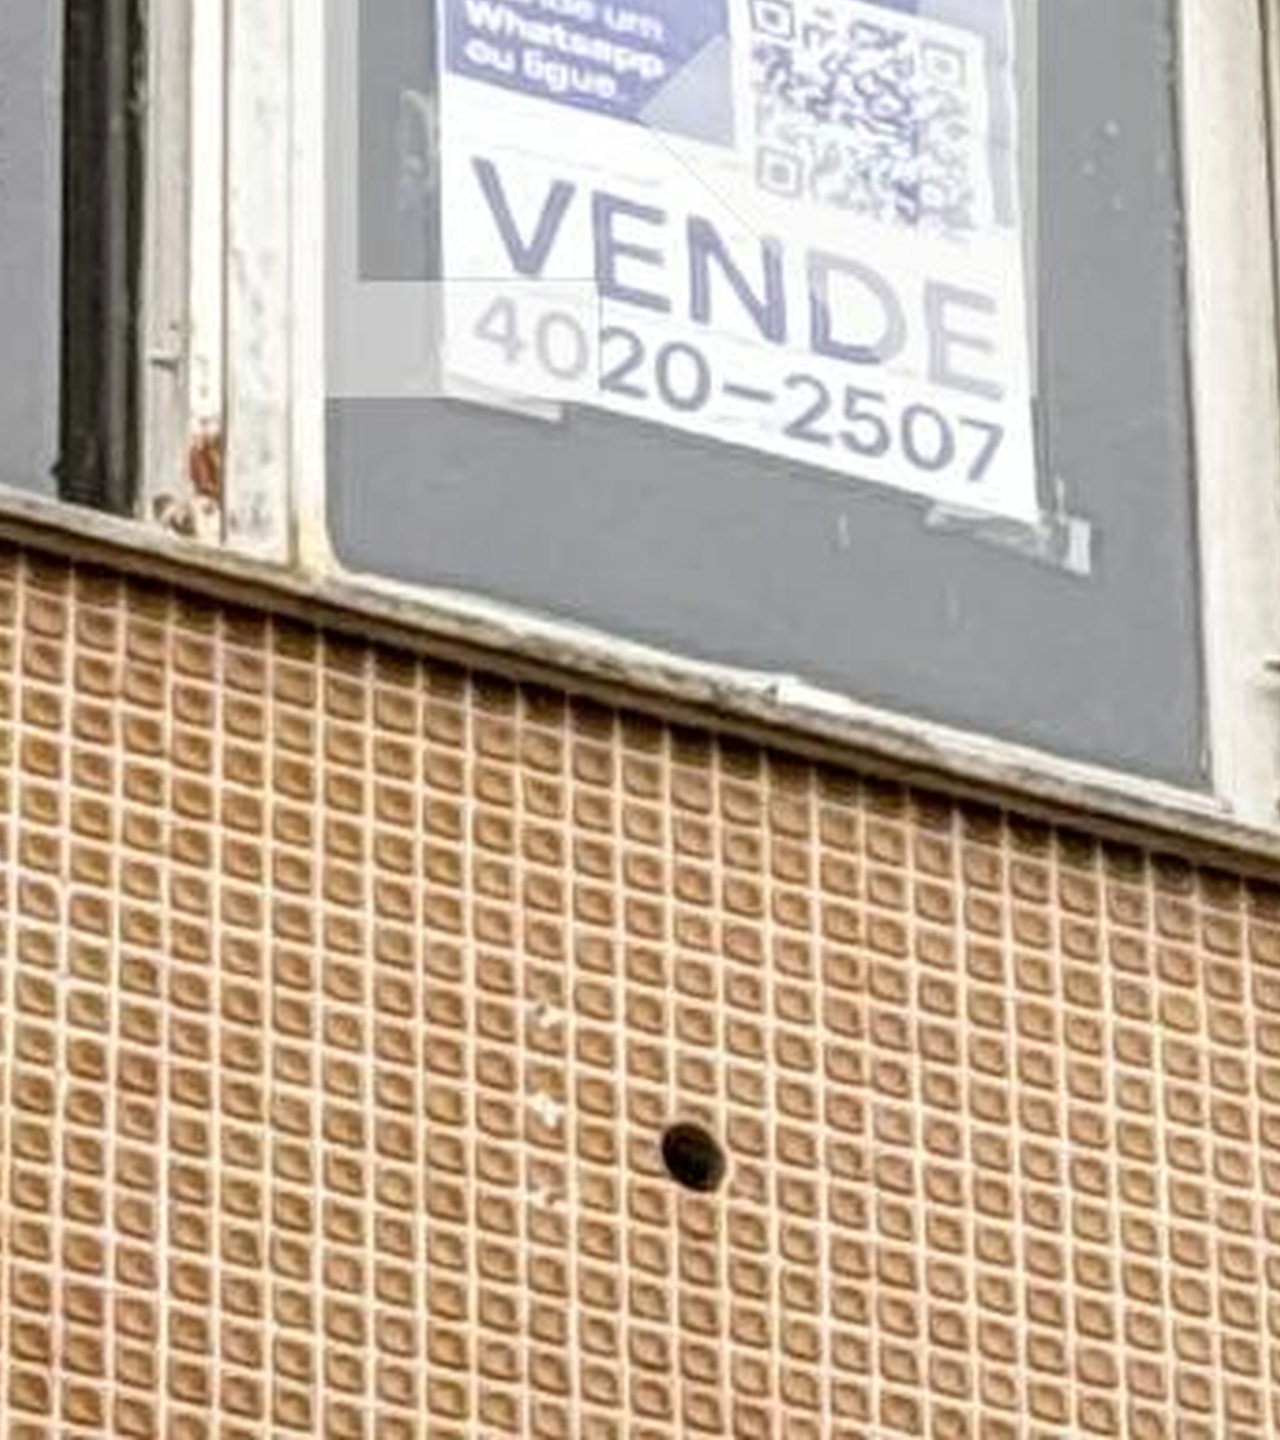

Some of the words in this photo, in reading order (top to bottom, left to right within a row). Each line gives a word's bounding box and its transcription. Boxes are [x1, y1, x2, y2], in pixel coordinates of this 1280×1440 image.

[464, 38, 516, 74] ou
[602, 6, 664, 43] um
[470, 155, 1006, 402] VENDE
[472, 295, 1007, 484] 4020-2507
